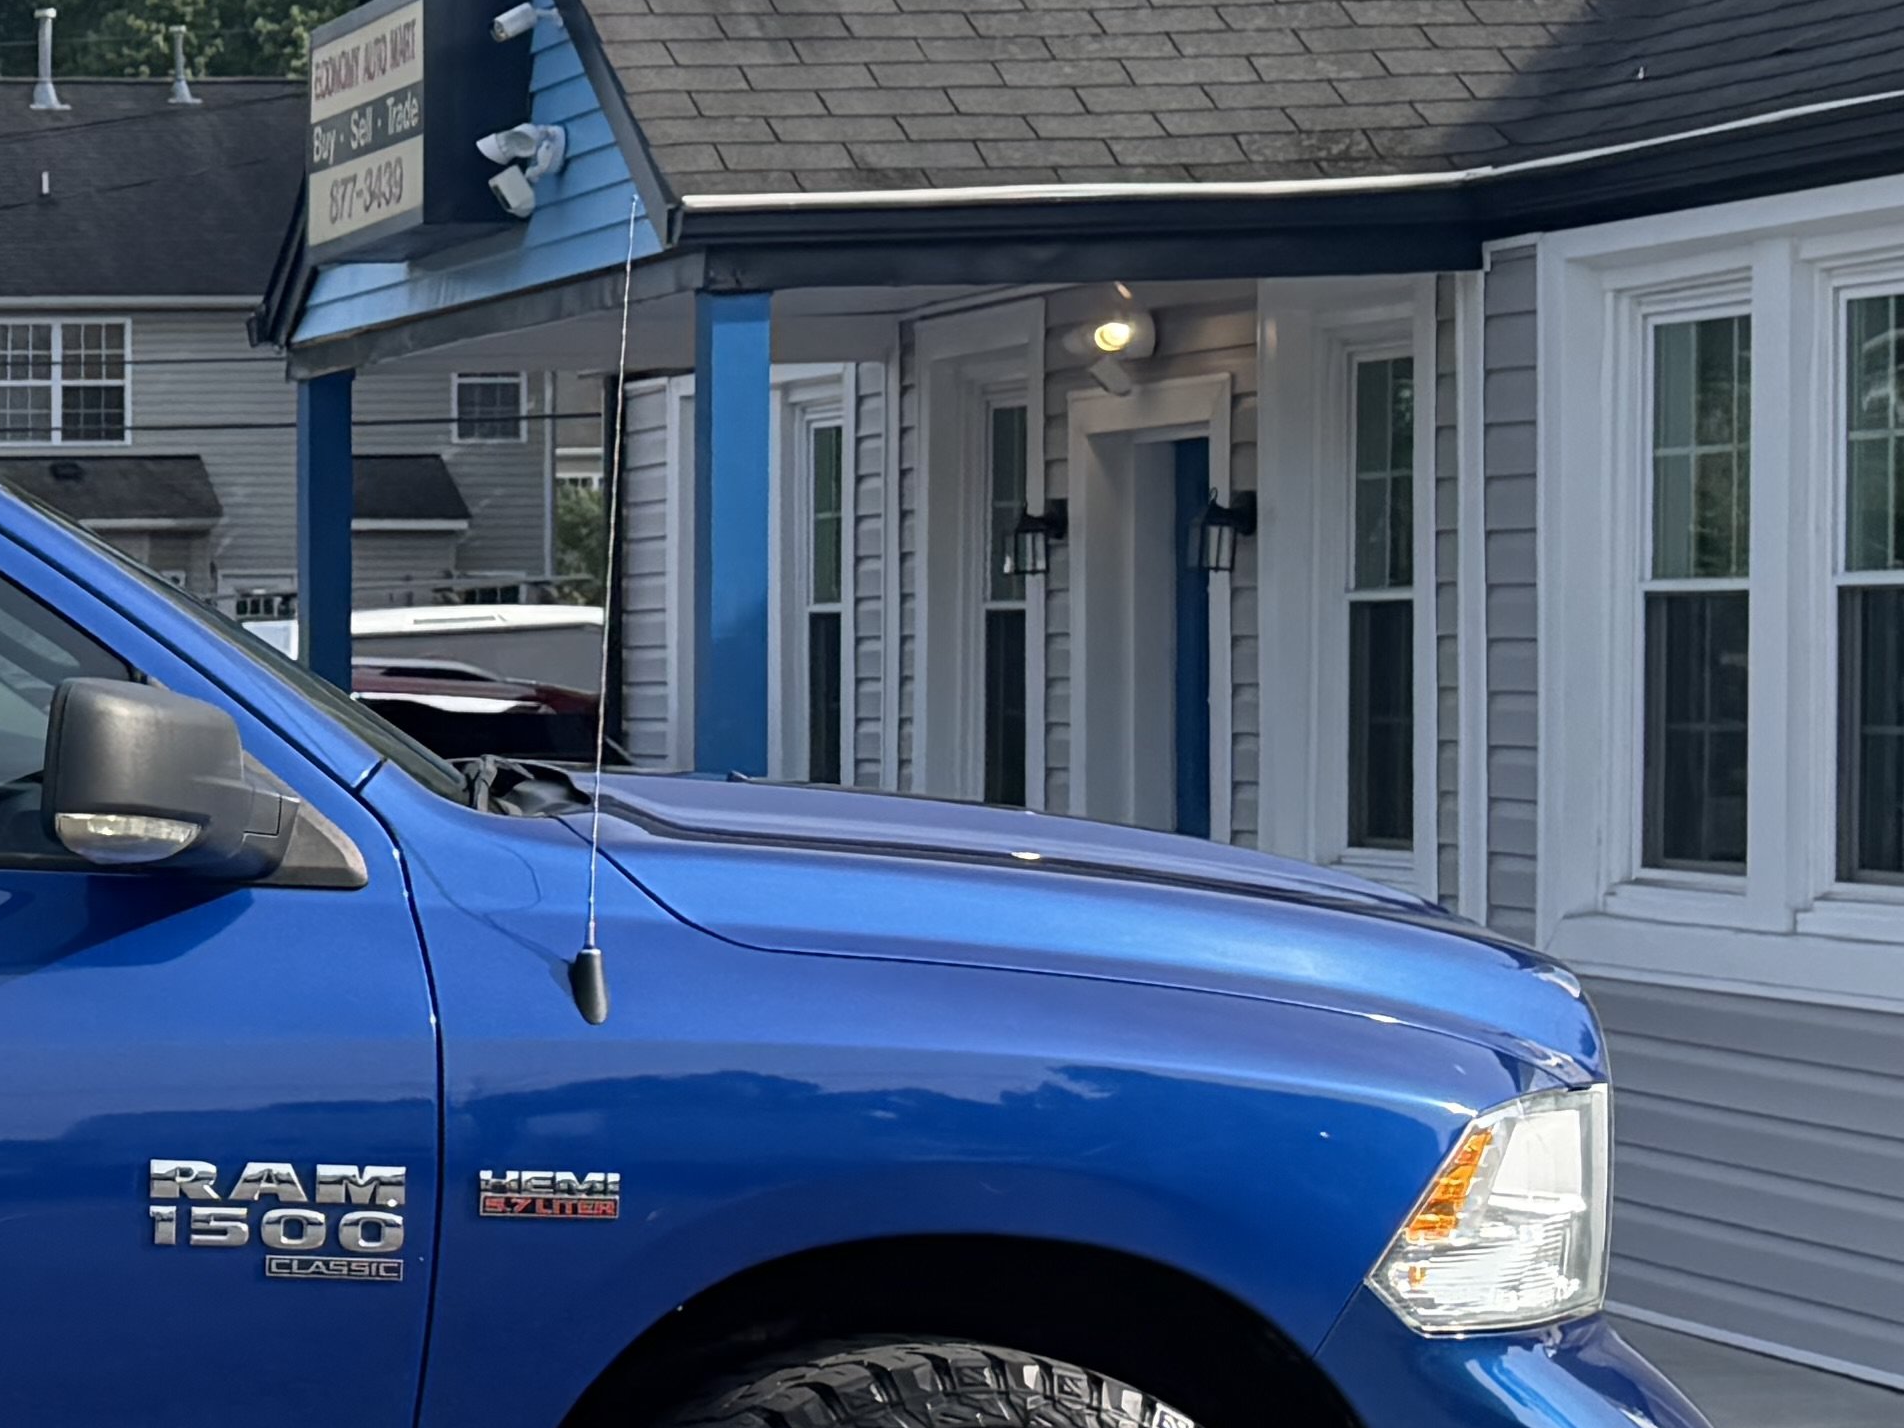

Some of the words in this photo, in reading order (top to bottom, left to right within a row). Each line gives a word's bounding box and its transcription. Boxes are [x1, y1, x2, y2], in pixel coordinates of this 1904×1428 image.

[315, 45, 360, 101] ECONOMY
[364, 34, 388, 83] AUTO
[313, 126, 336, 164] Buy
[351, 106, 373, 150] Sell
[386, 91, 420, 135] Trade
[330, 157, 404, 225] 877-3439
[149, 1159, 407, 1206] RAM
[479, 1170, 621, 1196] HEMI
[149, 1206, 405, 1253] 1500
[485, 1197, 532, 1214] 5.7
[535, 1198, 615, 1216] LITER
[270, 1259, 400, 1278] CLASSIC
